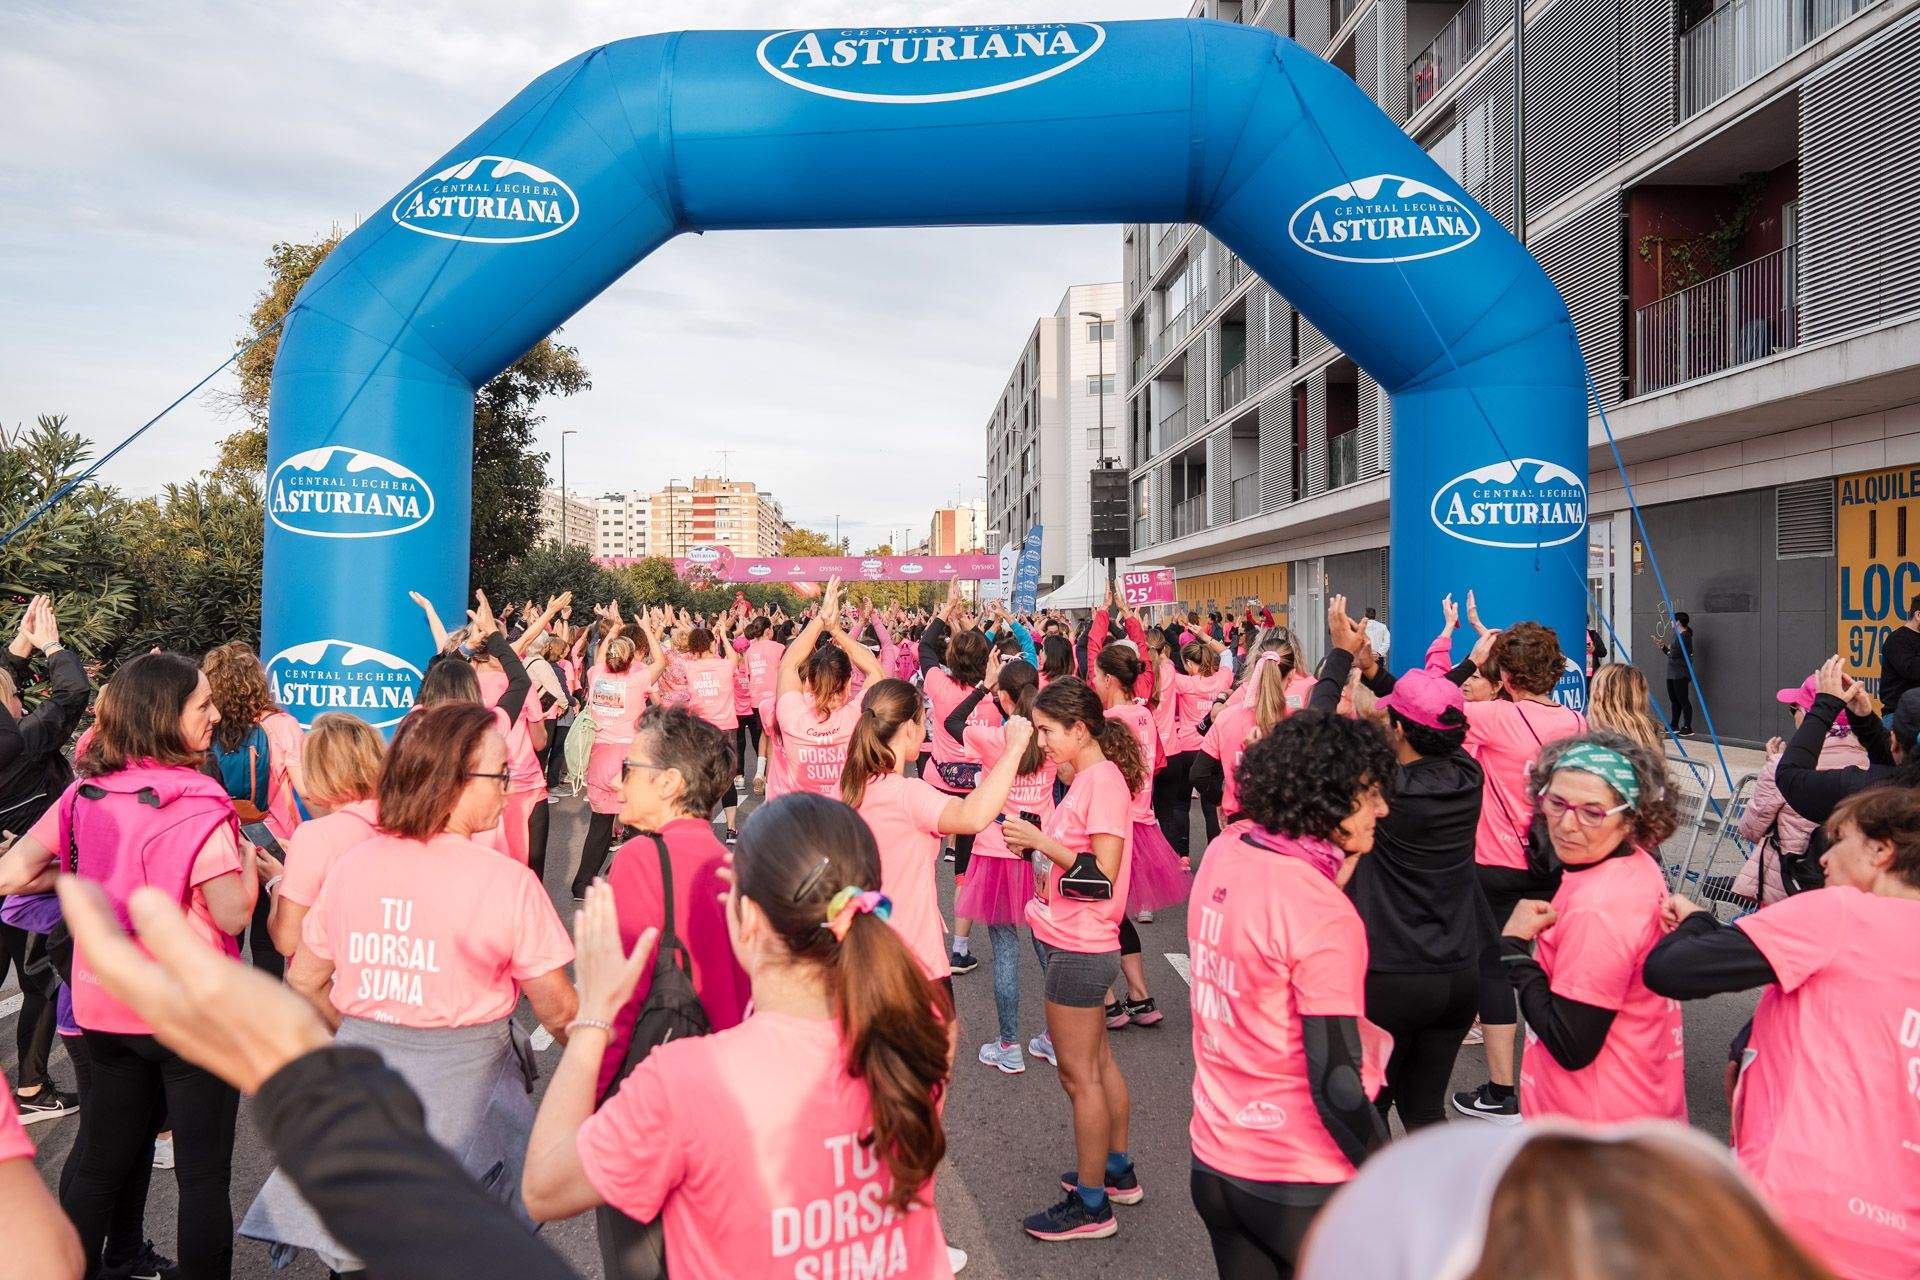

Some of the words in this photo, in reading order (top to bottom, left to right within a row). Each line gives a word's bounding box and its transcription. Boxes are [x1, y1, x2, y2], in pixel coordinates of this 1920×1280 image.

[841, 28, 947, 36] CENTRAL
[959, 24, 1067, 32] LECHERA
[781, 30, 1079, 68] ASTURIANA
[496, 184, 559, 197] LECHERA
[401, 191, 565, 224] ASTURIANA
[1335, 204, 1398, 216] CENTRAL
[1404, 203, 1460, 213] LECHERA
[1304, 211, 1471, 243] ASTURIANA
[273, 479, 421, 519] ASTURIANA
[290, 477, 346, 487] CENTRAL
[352, 478, 417, 491] LECHERA
[1540, 489, 1581, 498] LECHERA
[1841, 470, 1920, 506] ALQUILE
[1444, 492, 1583, 525] ASTURIANA
[1125, 573, 1150, 585] SUB
[270, 670, 415, 709] ASTURIANA
[285, 670, 341, 680] CENTRAL
[348, 672, 411, 682] LECHERA
[381, 897, 413, 931] TU
[1200, 905, 1224, 946] TU
[350, 932, 440, 973] DORSAL
[358, 968, 424, 1006] SUMA
[824, 1127, 879, 1188] TU
[1848, 1196, 1906, 1231] OYSHO
